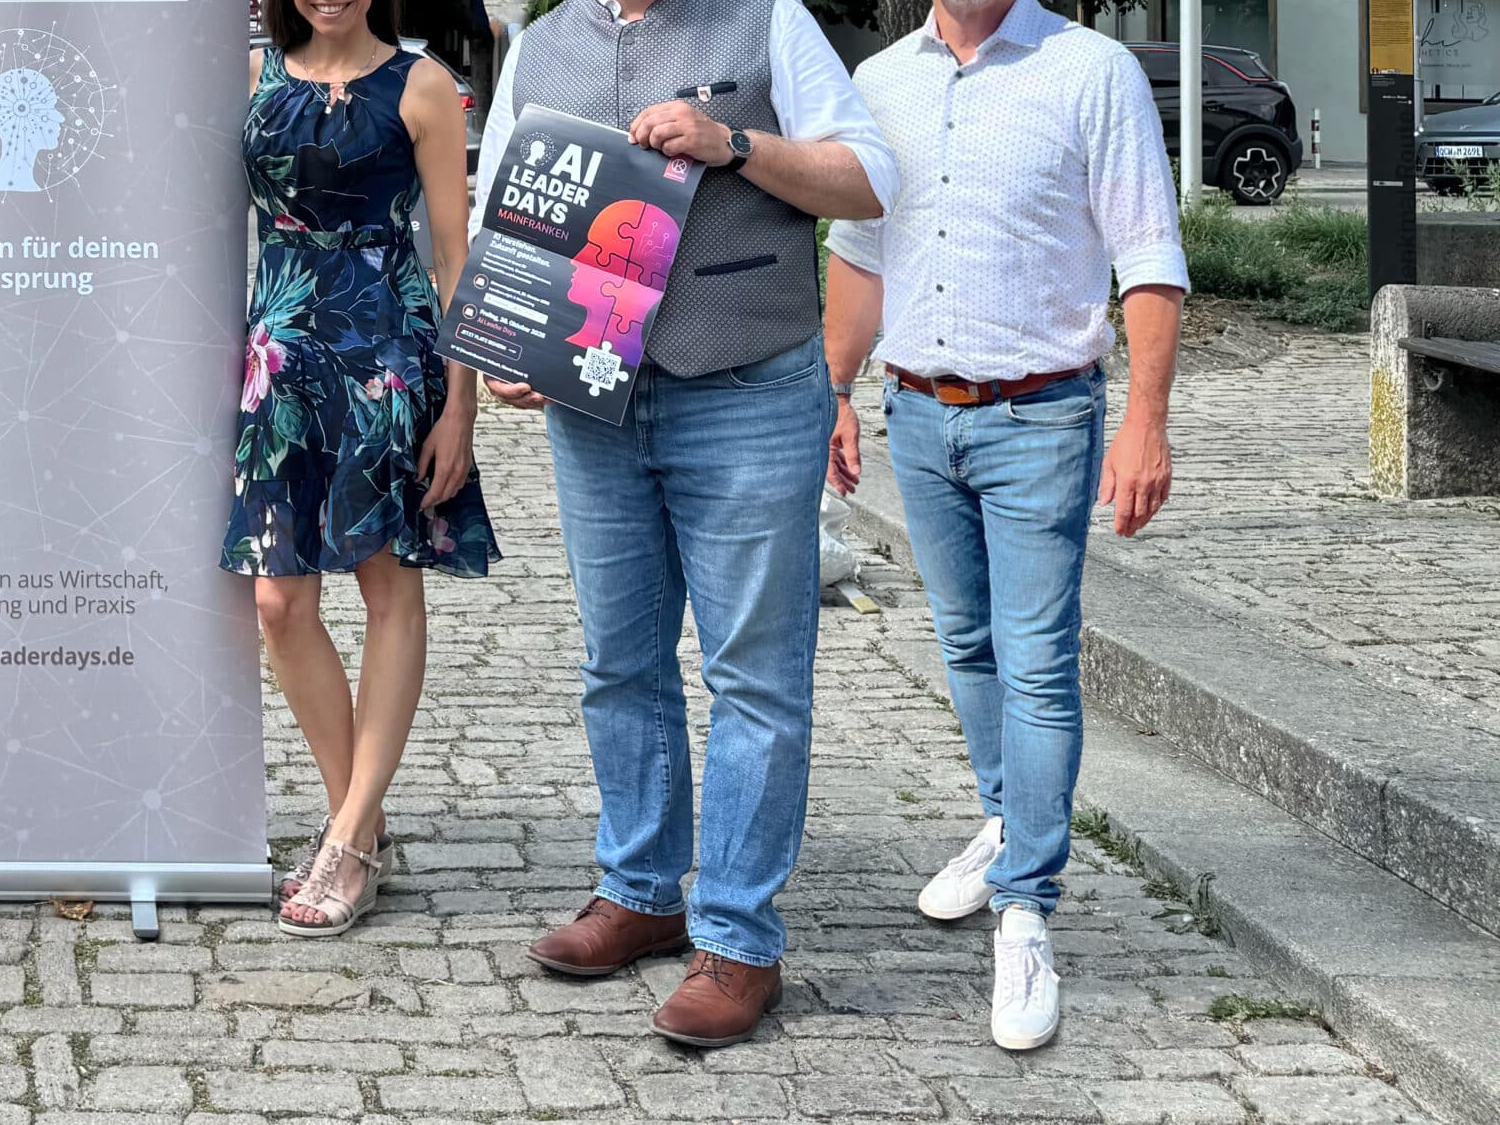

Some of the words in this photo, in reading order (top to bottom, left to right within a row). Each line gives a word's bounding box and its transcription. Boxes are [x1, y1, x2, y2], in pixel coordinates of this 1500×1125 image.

[549, 143, 603, 187] AI
[508, 165, 590, 208] LEADER
[502, 185, 568, 224] DAYS
[498, 208, 570, 241] MAINFRANKEN
[22, 235, 62, 259] für
[68, 236, 159, 259] deinen
[18, 574, 54, 589] aus
[59, 569, 169, 593] Wirtschaft,
[28, 594, 68, 615] und
[75, 595, 136, 615] Praxis
